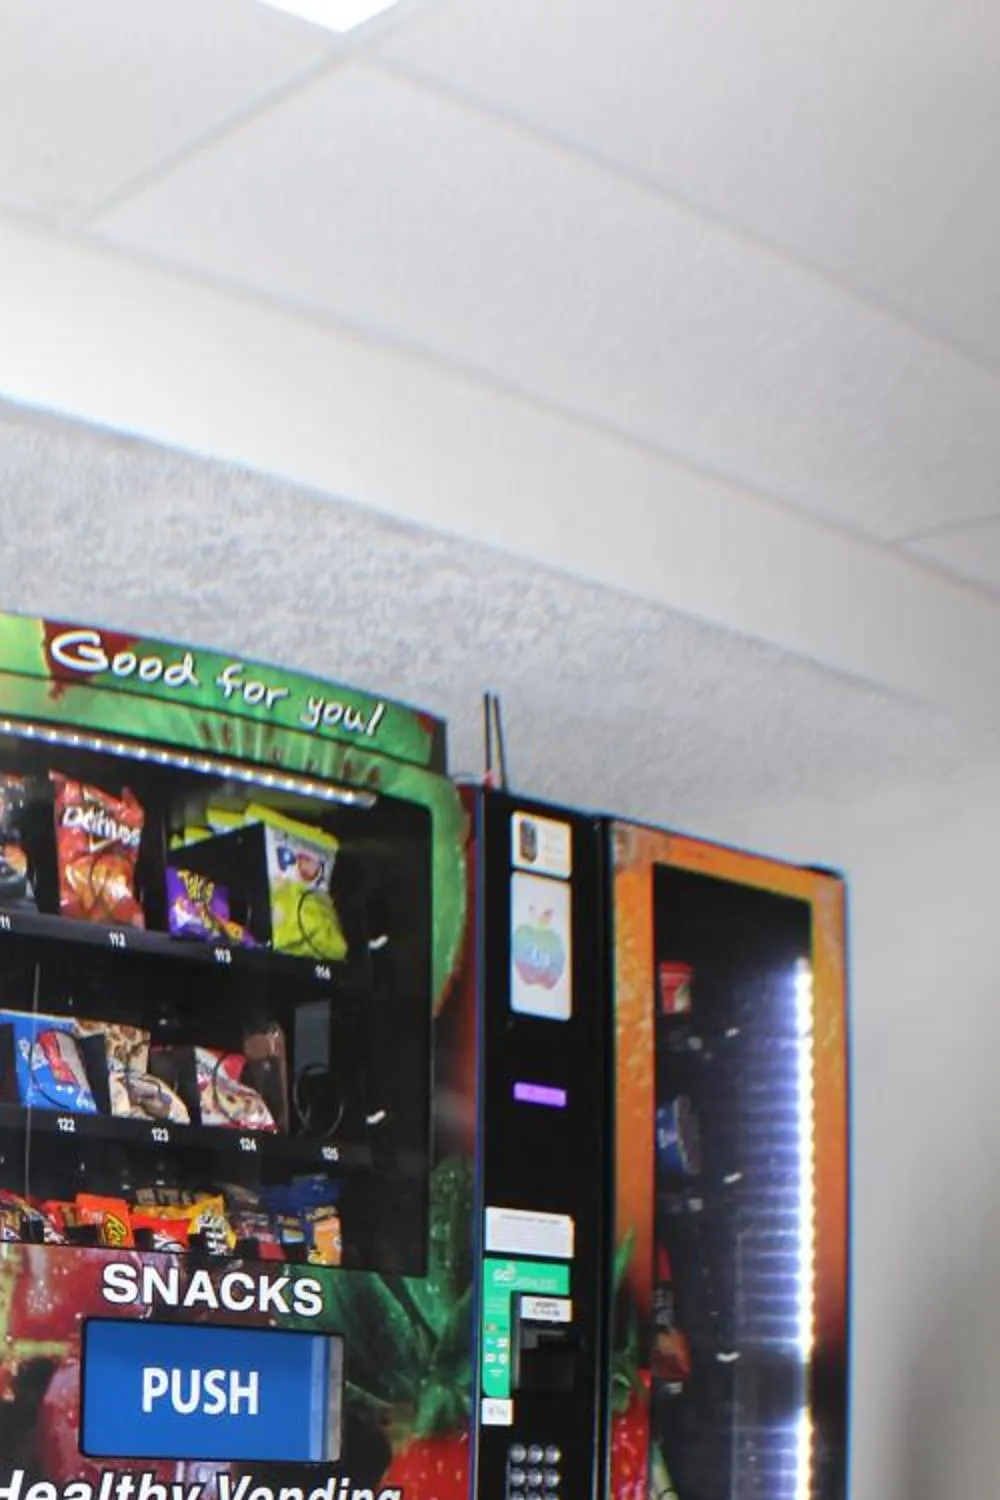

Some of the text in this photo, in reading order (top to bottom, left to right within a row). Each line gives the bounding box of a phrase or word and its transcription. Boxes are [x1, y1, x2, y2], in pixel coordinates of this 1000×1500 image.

[51, 631, 384, 736] Good for you!
[57, 1118, 75, 1133] 122
[151, 1127, 169, 1143] 123
[239, 1137, 257, 1151] 124
[102, 1262, 324, 1317] SNACKS
[141, 1367, 260, 1416] PUSH
